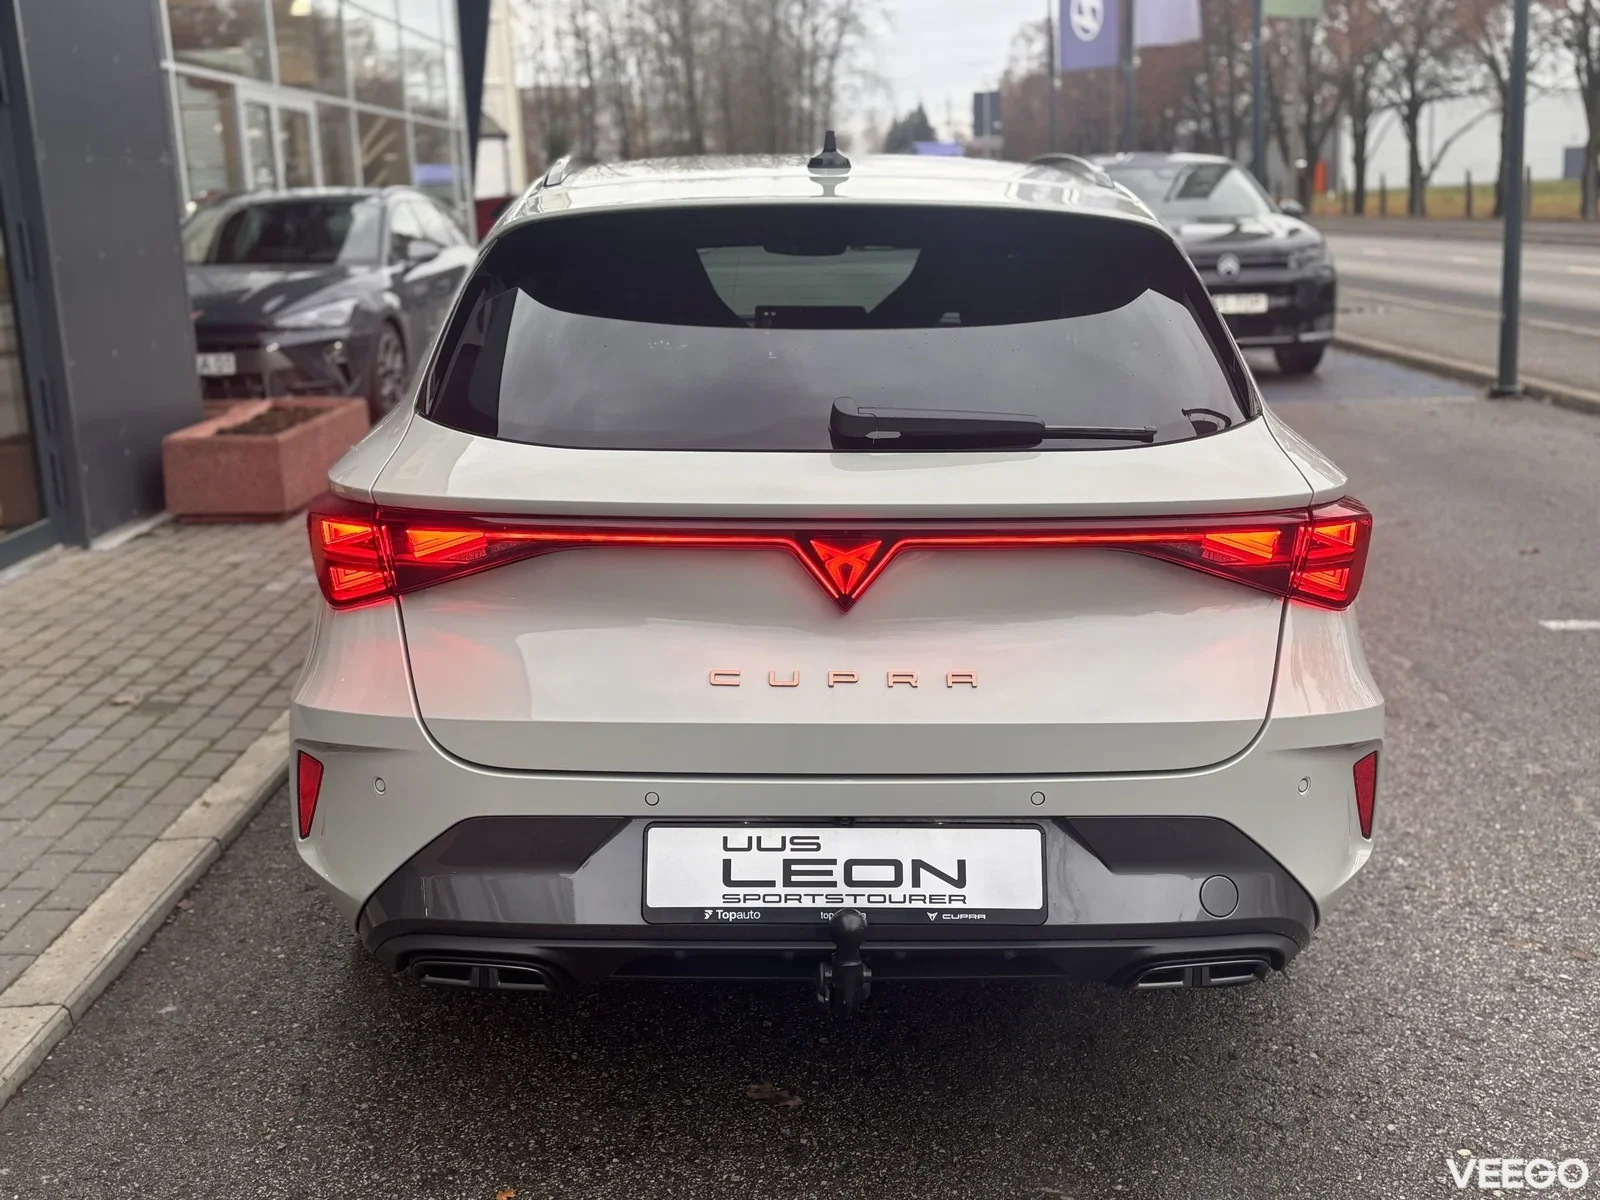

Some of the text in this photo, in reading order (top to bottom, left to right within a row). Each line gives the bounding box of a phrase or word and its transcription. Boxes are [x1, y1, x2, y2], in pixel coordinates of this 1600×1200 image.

[709, 670, 978, 688] CUPRA
[722, 835, 822, 852] UUS
[722, 858, 967, 889] LEON
[722, 893, 967, 904] SPORTSTOURER
[715, 909, 761, 922] Topauto
